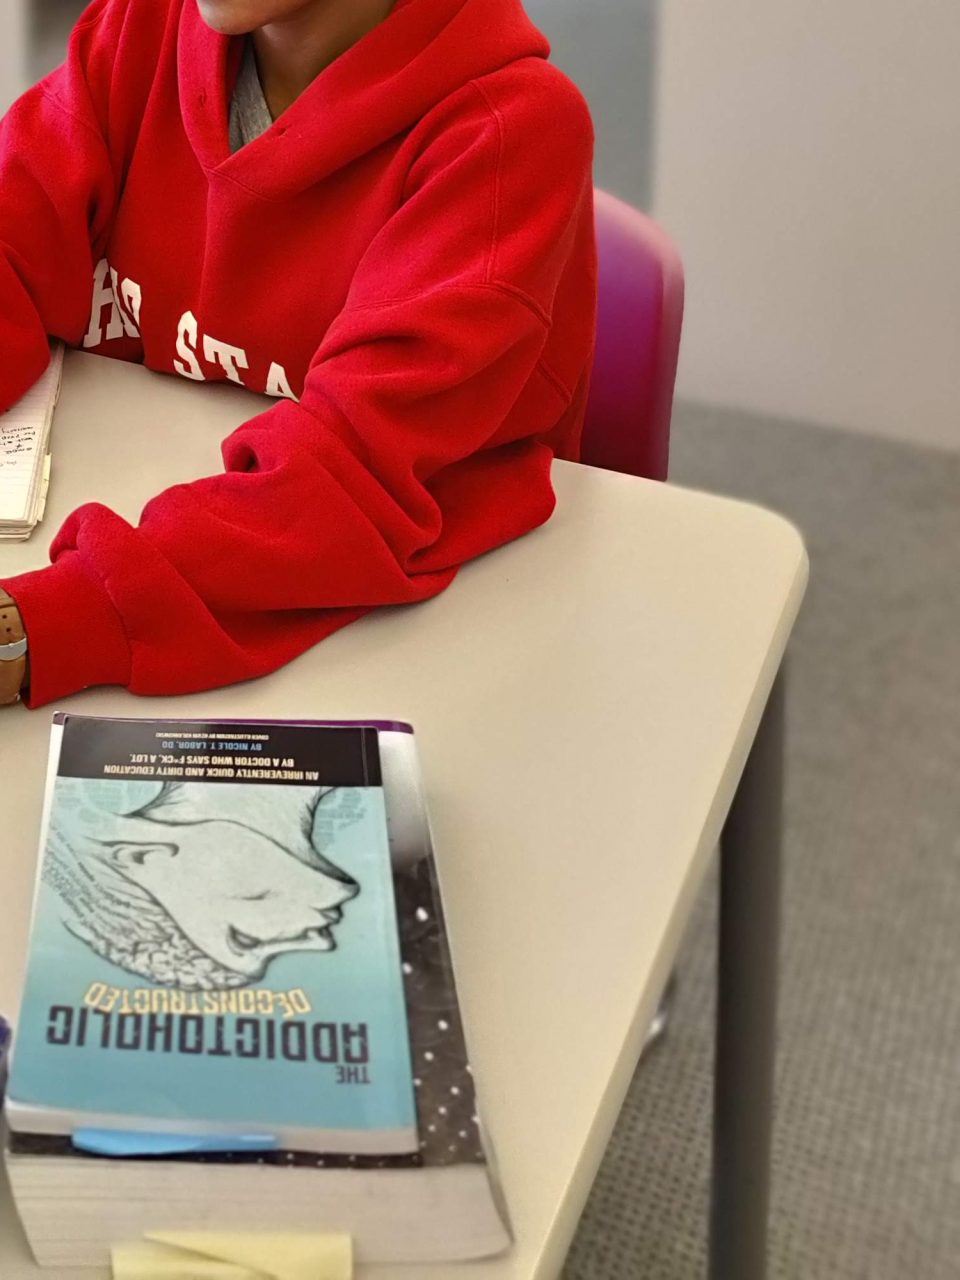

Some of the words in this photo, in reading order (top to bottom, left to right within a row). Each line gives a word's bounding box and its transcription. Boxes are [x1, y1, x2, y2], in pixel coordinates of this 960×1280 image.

[161, 740, 174, 749] DO
[218, 742, 249, 751] NICOLE
[250, 743, 262, 751] BY
[129, 753, 149, 763] LOT.
[150, 754, 157, 763] A
[186, 754, 210, 765] SAYS
[211, 755, 234, 765] WHO
[234, 756, 271, 767] DOCTOR
[273, 758, 280, 767] A
[281, 758, 295, 768] BY
[103, 764, 155, 775] EDUCATION
[155, 766, 184, 776] DIRTY
[184, 766, 204, 776] AND
[206, 767, 235, 778] QUICK
[236, 769, 304, 780] IRREVERENTLY
[305, 771, 319, 781] AN
[83, 981, 312, 1018] DECONSTRUCTED
[46, 1005, 369, 1064] ADDICTOHOLIC
[335, 1065, 371, 1085] THE
